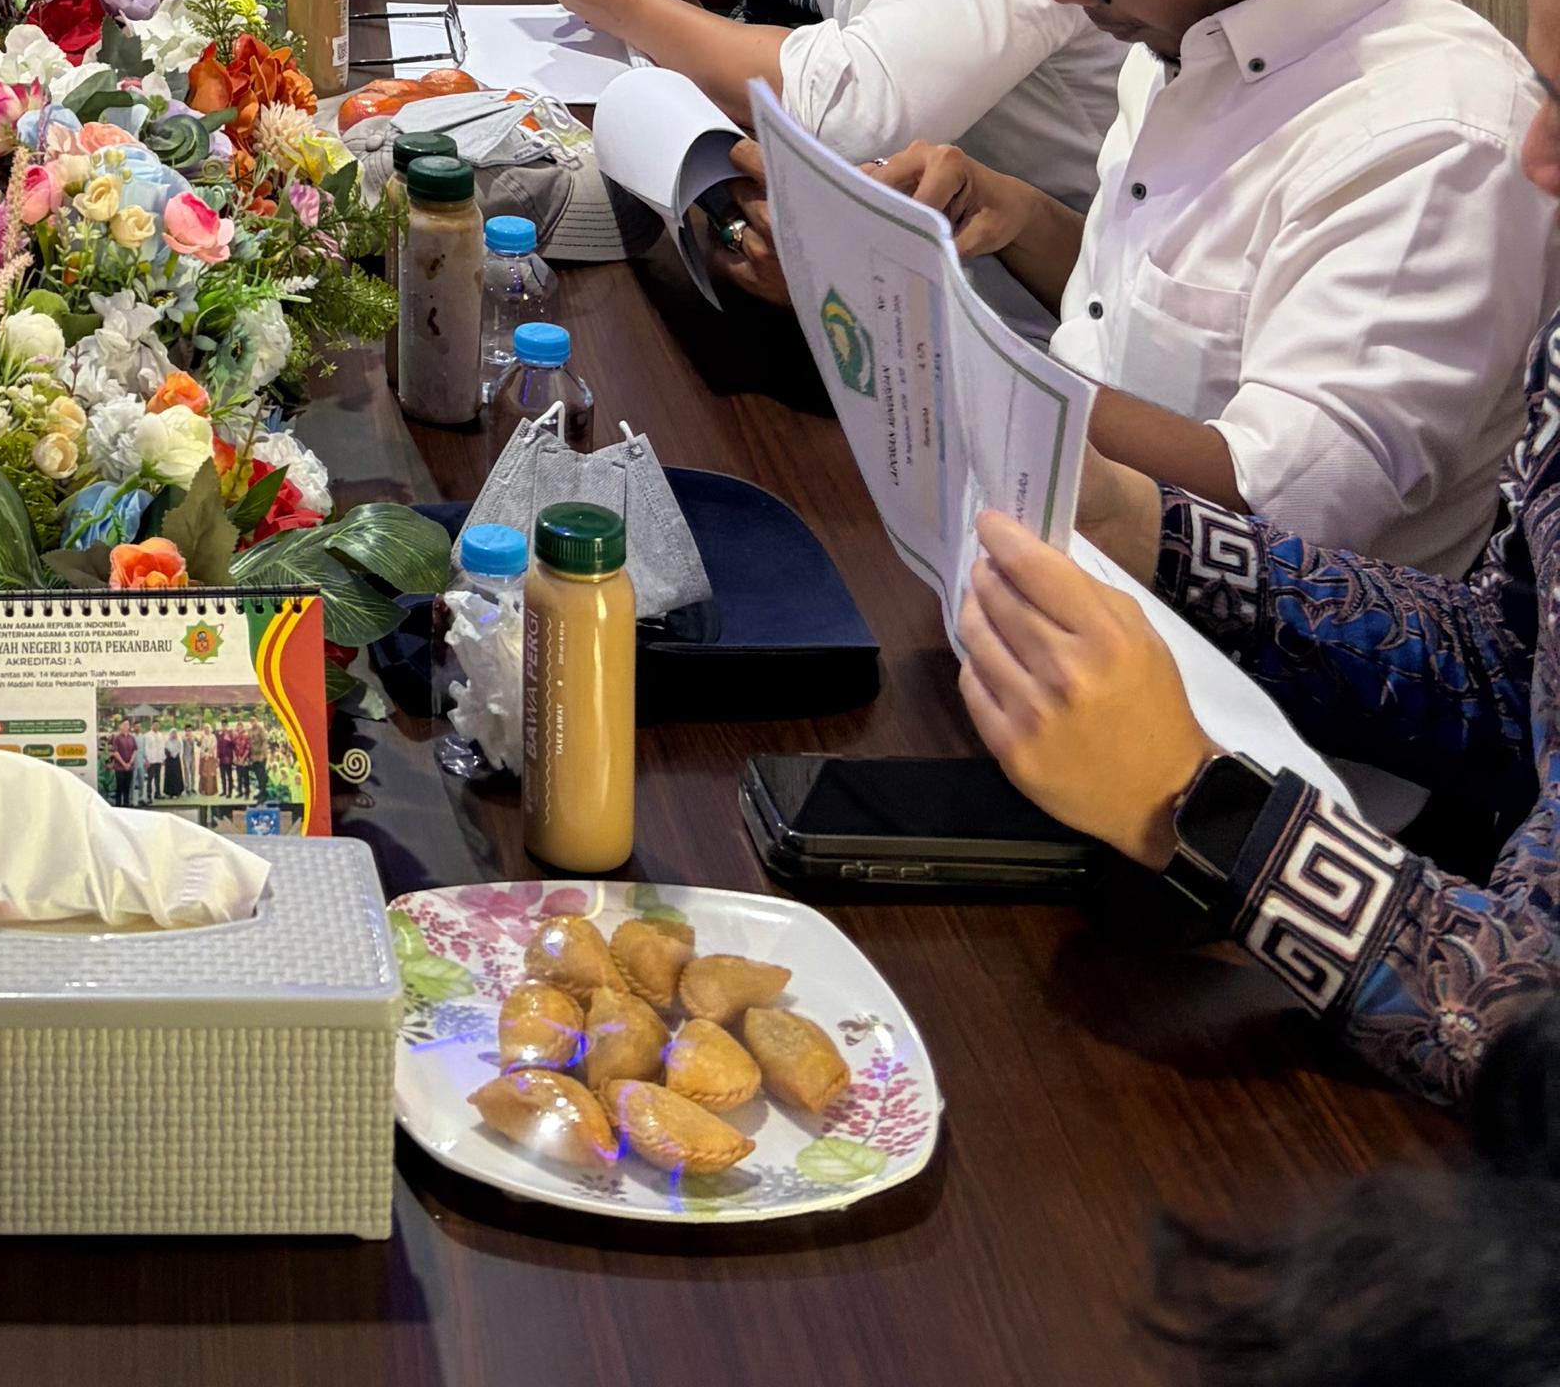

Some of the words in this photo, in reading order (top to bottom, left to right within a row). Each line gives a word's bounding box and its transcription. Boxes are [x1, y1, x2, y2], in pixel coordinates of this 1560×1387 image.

[21, 641, 61, 654] NEGERI
[64, 641, 71, 653] 3
[73, 641, 102, 653] KOTA
[105, 640, 173, 653] PEKANBARU
[526, 608, 539, 682] PERGI
[5, 657, 67, 666] AKREDITASI
[73, 657, 82, 665] A
[526, 687, 538, 759] BAWA
[556, 703, 564, 730] AWAY
[556, 732, 564, 756] TAKE
